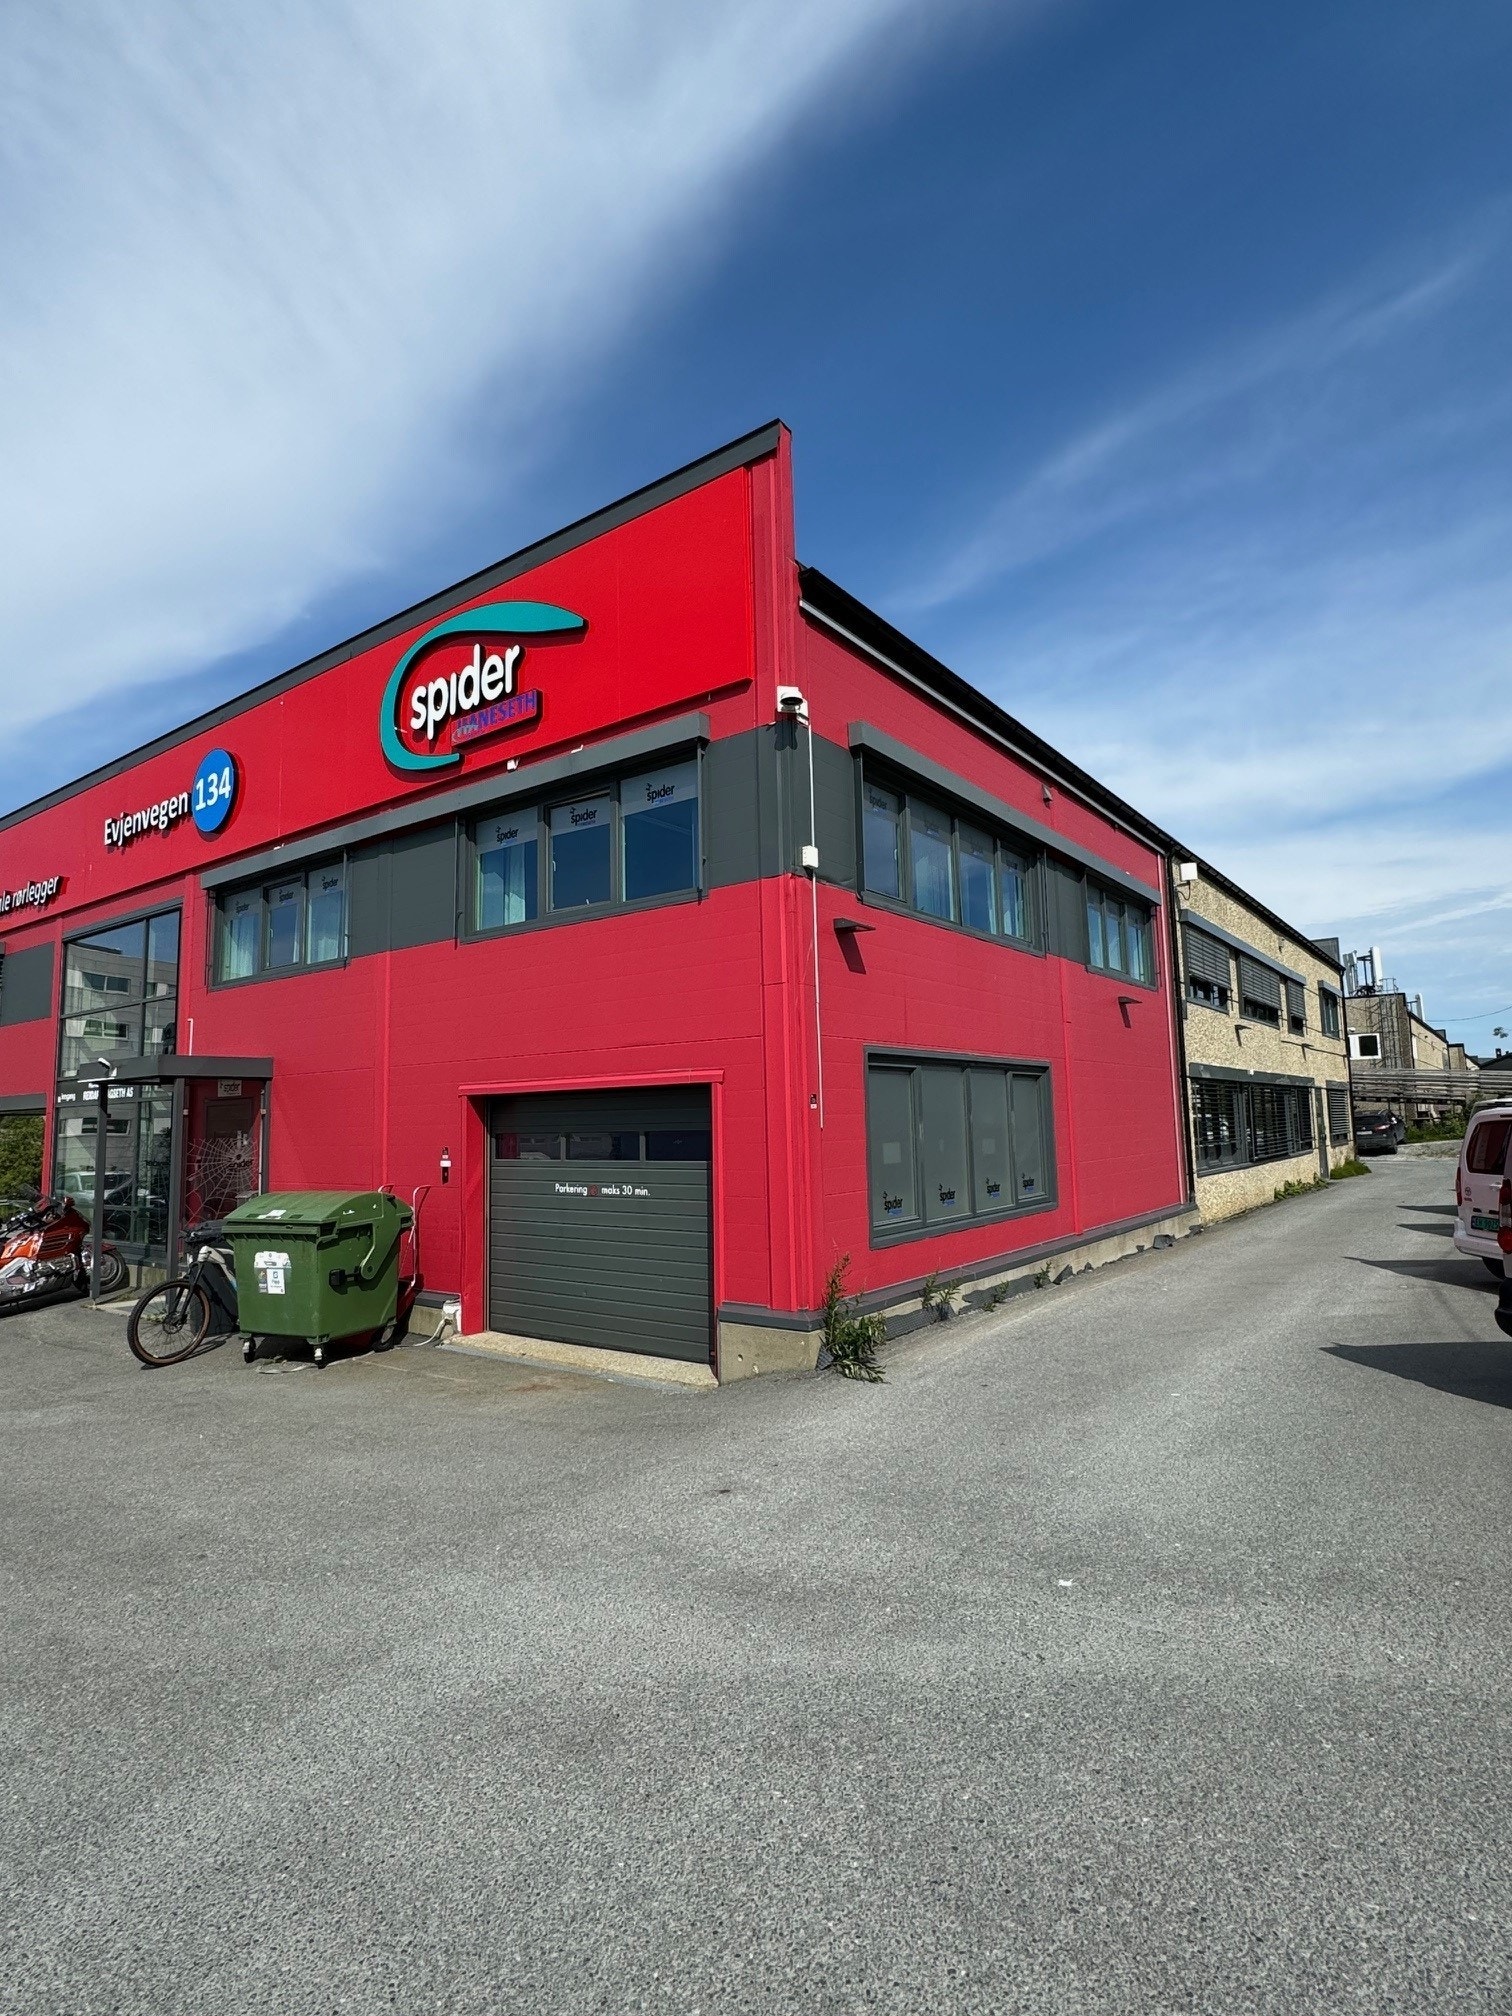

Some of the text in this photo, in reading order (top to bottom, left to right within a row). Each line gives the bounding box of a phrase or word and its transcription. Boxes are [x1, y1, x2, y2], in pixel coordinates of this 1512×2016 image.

[410, 643, 520, 740] spider
[646, 784, 675, 803] spider
[104, 766, 232, 846] Evjenvegen 134
[570, 808, 597, 826] spider
[496, 826, 519, 844] spider
[12, 875, 60, 907] rørlegger
[554, 1183, 651, 1196] Parkering maks 30 min.
